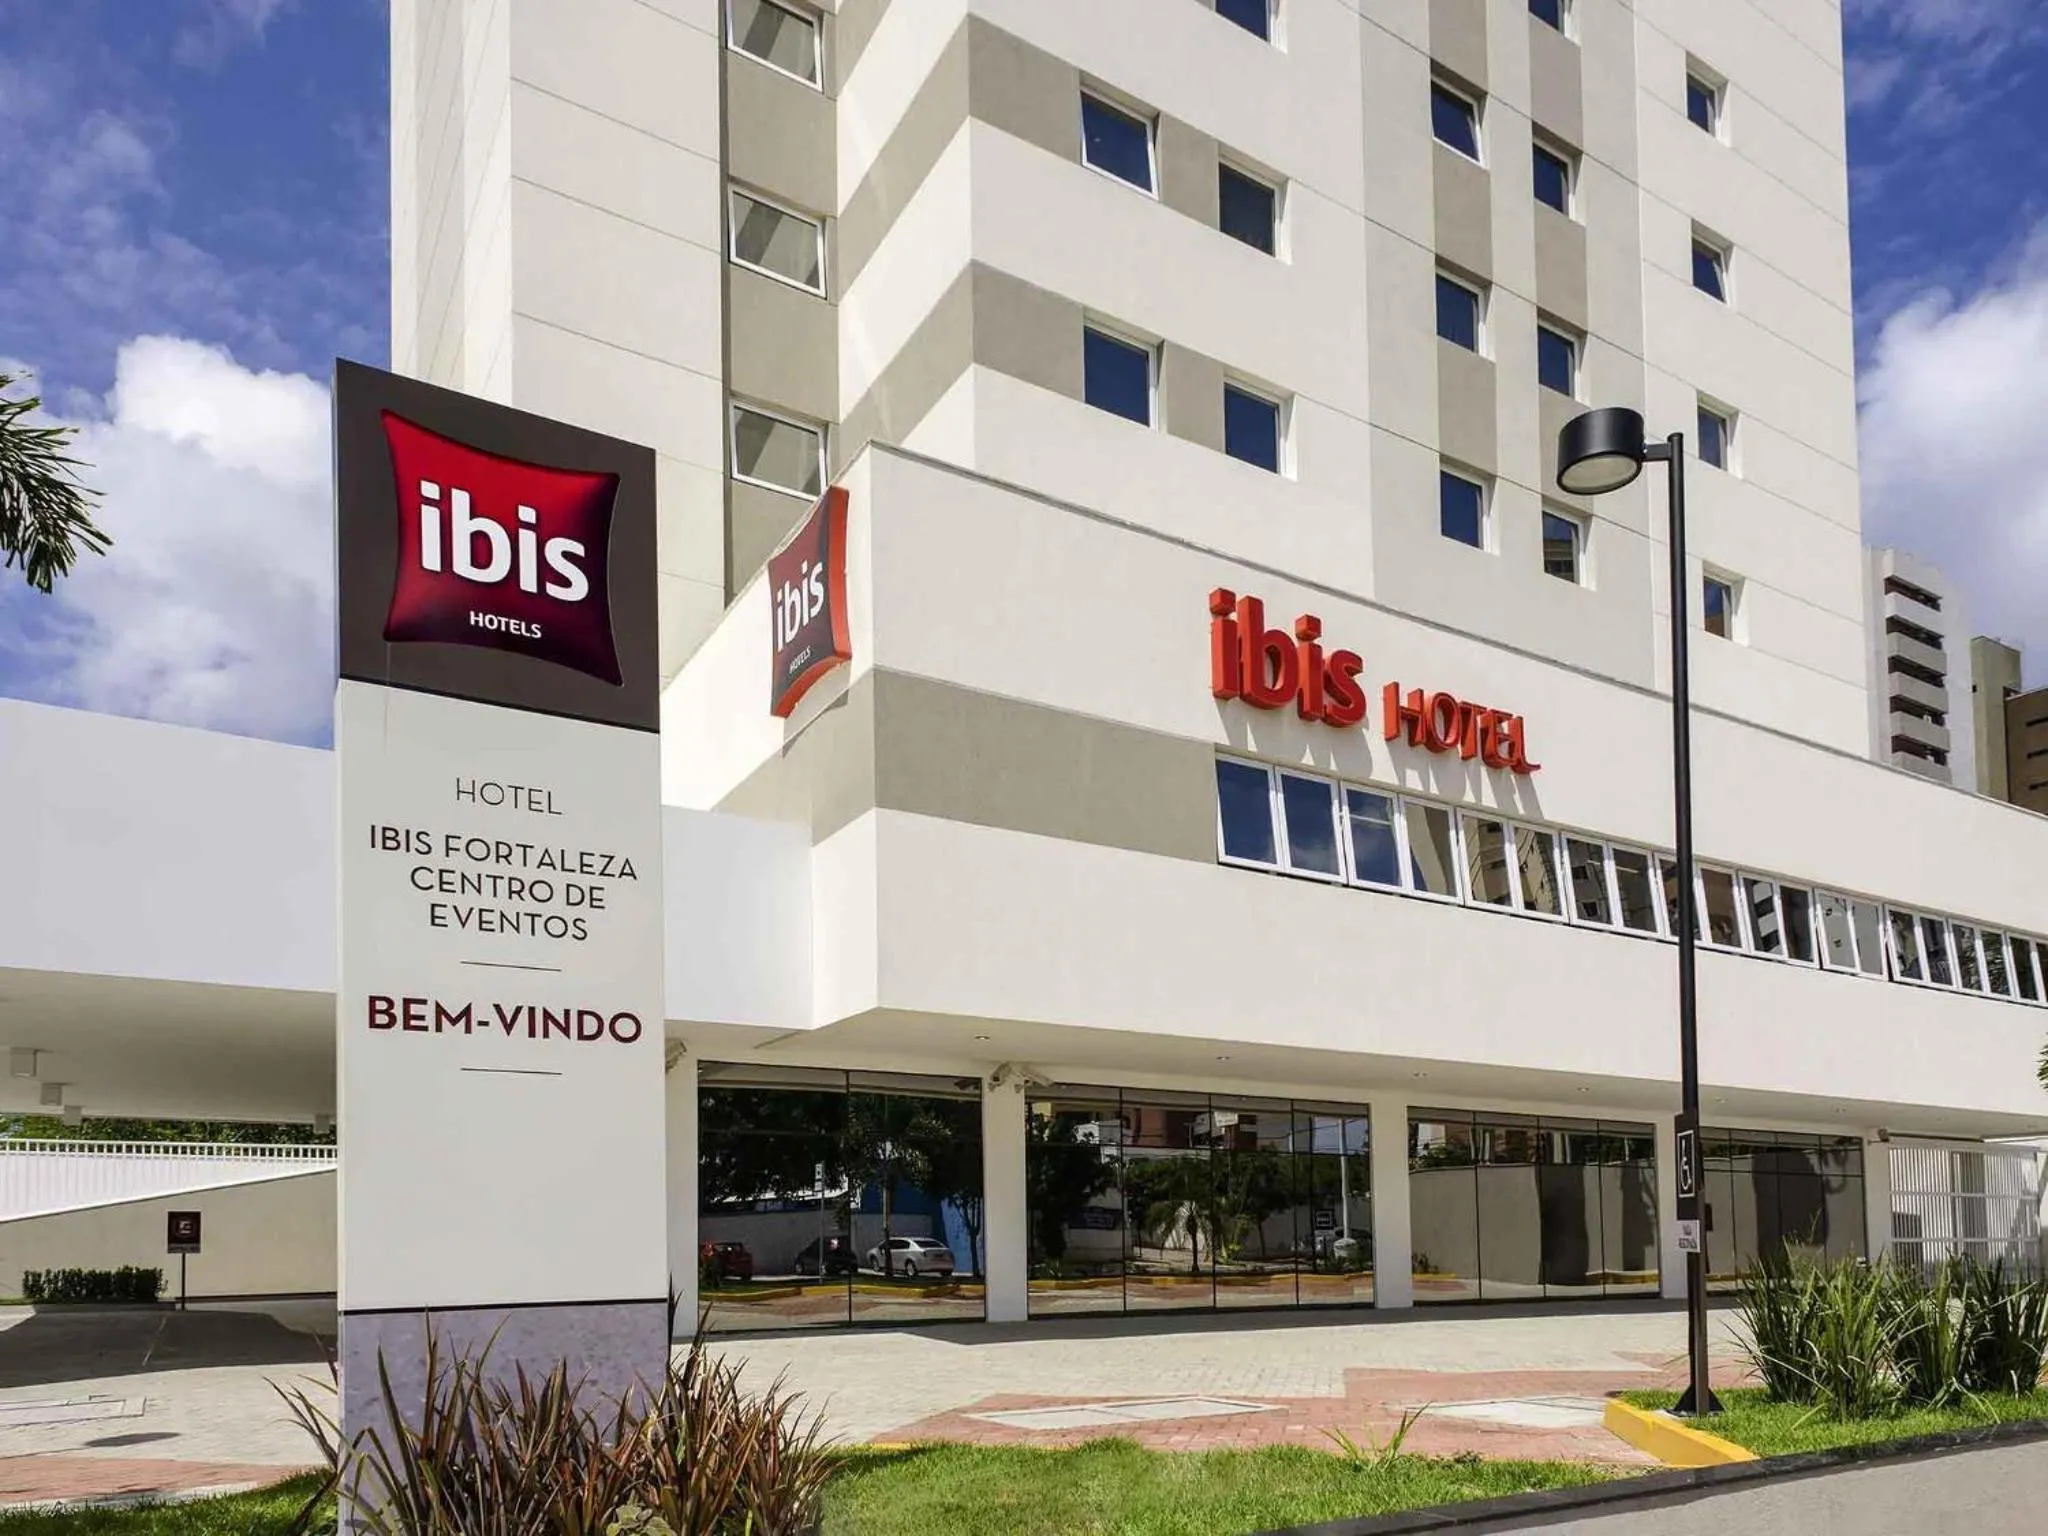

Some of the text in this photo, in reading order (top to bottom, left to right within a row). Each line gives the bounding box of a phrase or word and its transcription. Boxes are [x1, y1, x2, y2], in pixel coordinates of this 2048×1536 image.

[419, 480, 589, 601] ibis
[469, 610, 542, 638] HOTELS
[776, 560, 825, 653] ibis
[1209, 587, 1541, 774] ibis HOTEL
[456, 777, 562, 815] HOTEL
[370, 825, 637, 880] IBIS FORTALEZA
[410, 866, 605, 909] CENTRO DE
[430, 903, 588, 941] EVENTOS
[368, 995, 642, 1044] BEM-VINDO
